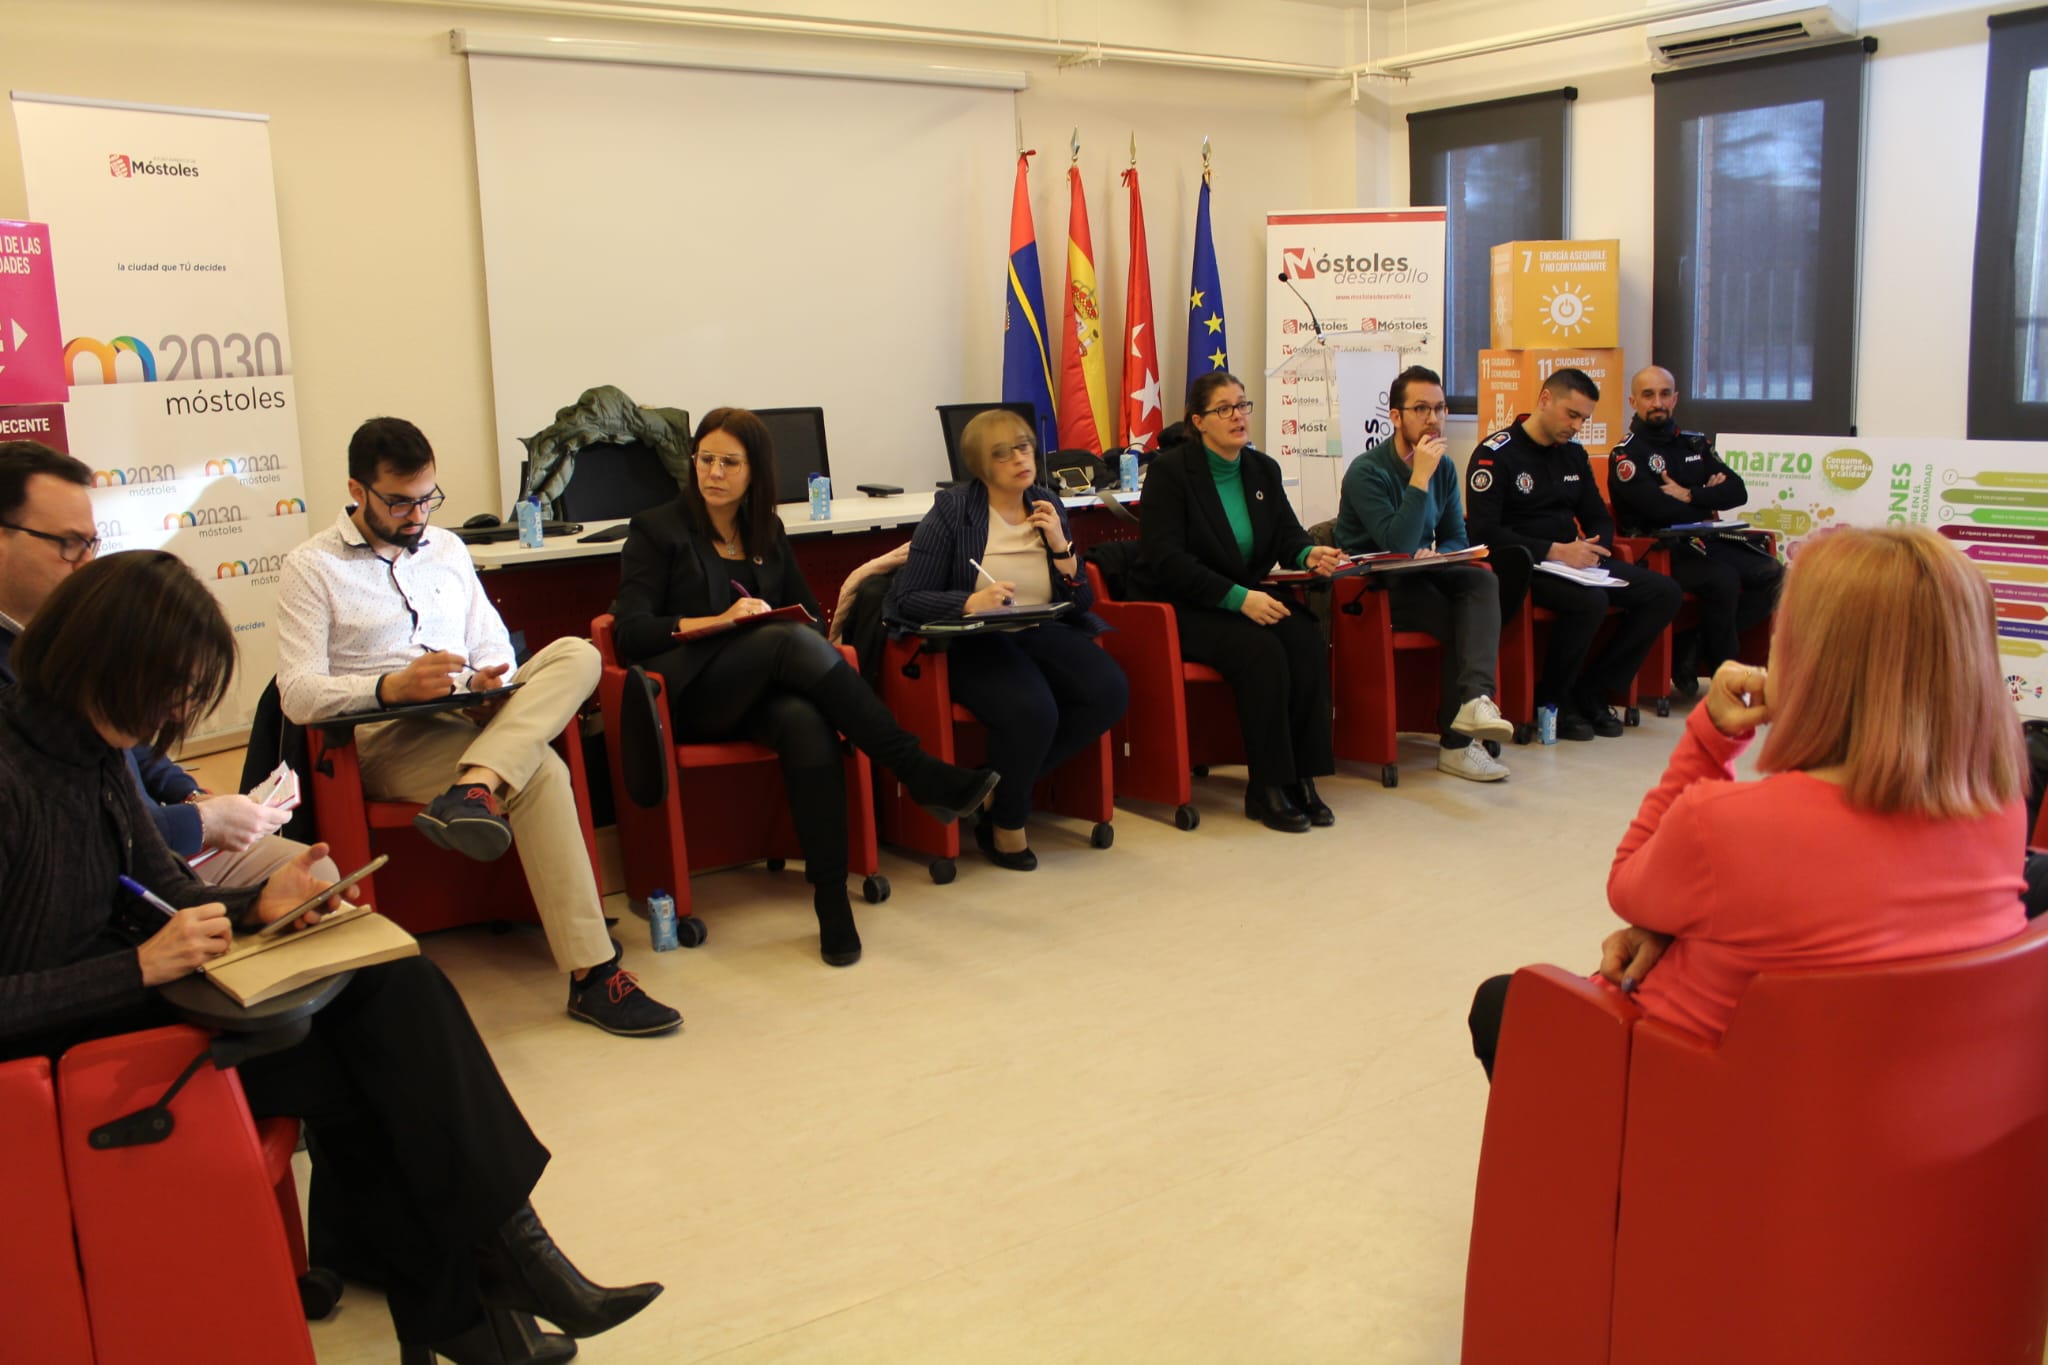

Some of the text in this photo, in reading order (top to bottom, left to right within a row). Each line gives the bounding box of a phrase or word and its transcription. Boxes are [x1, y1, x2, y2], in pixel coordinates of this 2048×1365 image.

[132, 160, 199, 178] Móstoles
[4, 236, 19, 254] DE
[20, 236, 42, 255] LAS
[117, 263, 125, 271] la
[127, 262, 159, 271] ciudad
[180, 262, 191, 271] TÚ
[193, 263, 227, 272] decides
[1522, 250, 1532, 273] 7
[1334, 268, 1429, 285] desarrollo
[1299, 321, 1348, 331] Mótoles
[1378, 319, 1428, 330] Móstoles
[1538, 357, 1597, 380] 11 CIUDADES Y
[166, 386, 286, 415] móstoles
[1725, 450, 1813, 474] marzo
[1825, 456, 1863, 464] Consume
[239, 472, 281, 486] móstoles
[1837, 470, 1866, 478] calidad
[129, 484, 177, 497] móstoles
[1796, 516, 1806, 529] 12
[199, 524, 242, 538] móstoles
[251, 575, 280, 587] mósto
[234, 621, 266, 632] decides
